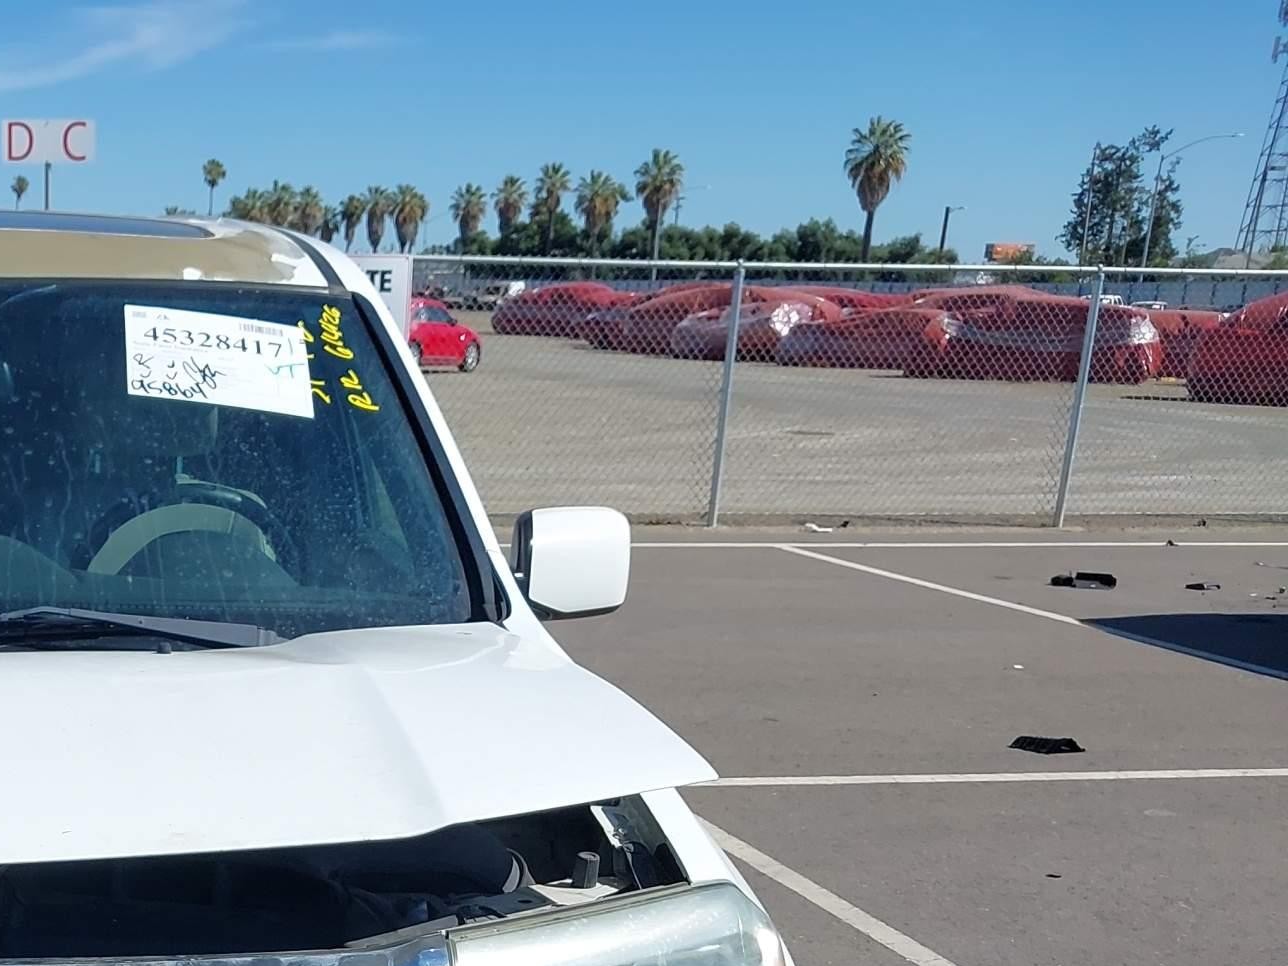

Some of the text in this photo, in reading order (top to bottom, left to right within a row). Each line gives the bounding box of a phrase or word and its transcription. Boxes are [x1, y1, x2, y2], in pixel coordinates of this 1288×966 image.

[8, 122, 87, 161] D C
[144, 327, 282, 358] 45328417
